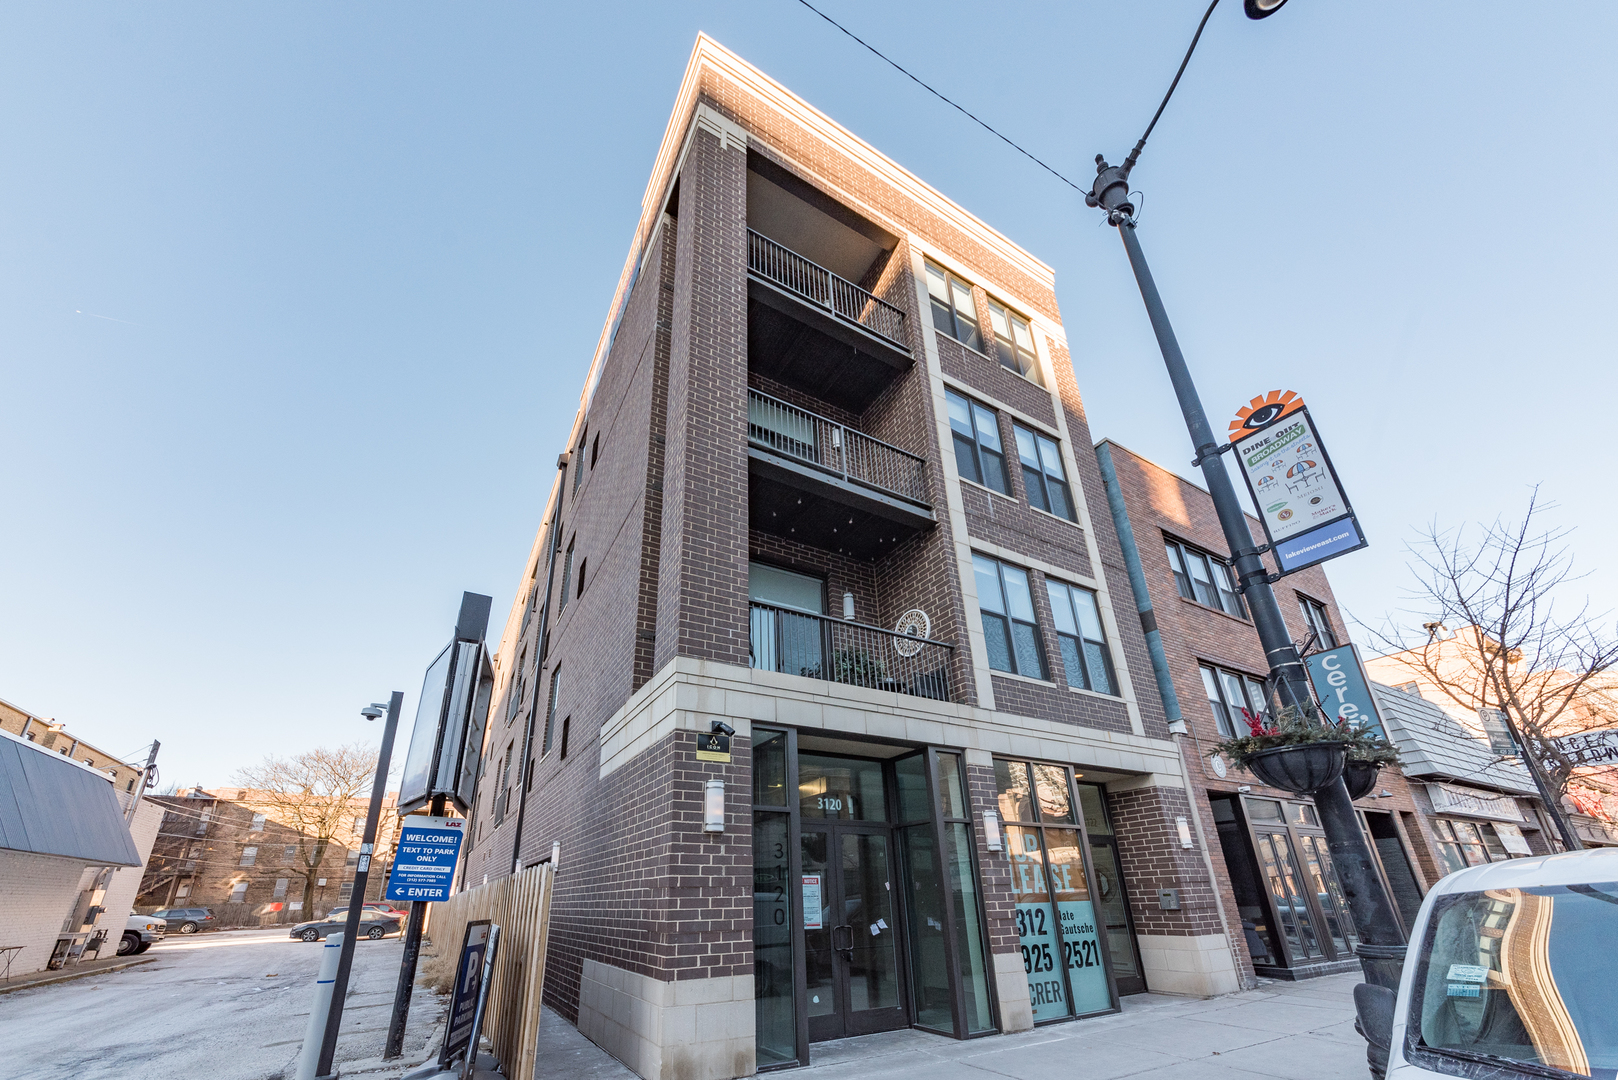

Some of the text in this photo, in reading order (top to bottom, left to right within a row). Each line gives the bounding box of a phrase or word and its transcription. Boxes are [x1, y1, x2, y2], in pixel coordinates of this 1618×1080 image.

[1242, 421, 1300, 455] DINE OUT
[1251, 427, 1302, 464] BROADWAY
[1280, 446, 1290, 456] the
[1290, 434, 1311, 449] streets
[1285, 531, 1350, 559] lakevieweast.com
[817, 797, 842, 811] 3120
[402, 846, 455, 856] TEXT TO PARK
[406, 833, 458, 844] WELCOME!
[407, 887, 443, 897] ENTER
[1008, 863, 1075, 894] LEASE
[1015, 908, 1047, 937] 312
[1059, 910, 1075, 921] ate
[1021, 940, 1100, 974] 925 2521
[463, 951, 479, 994] P
